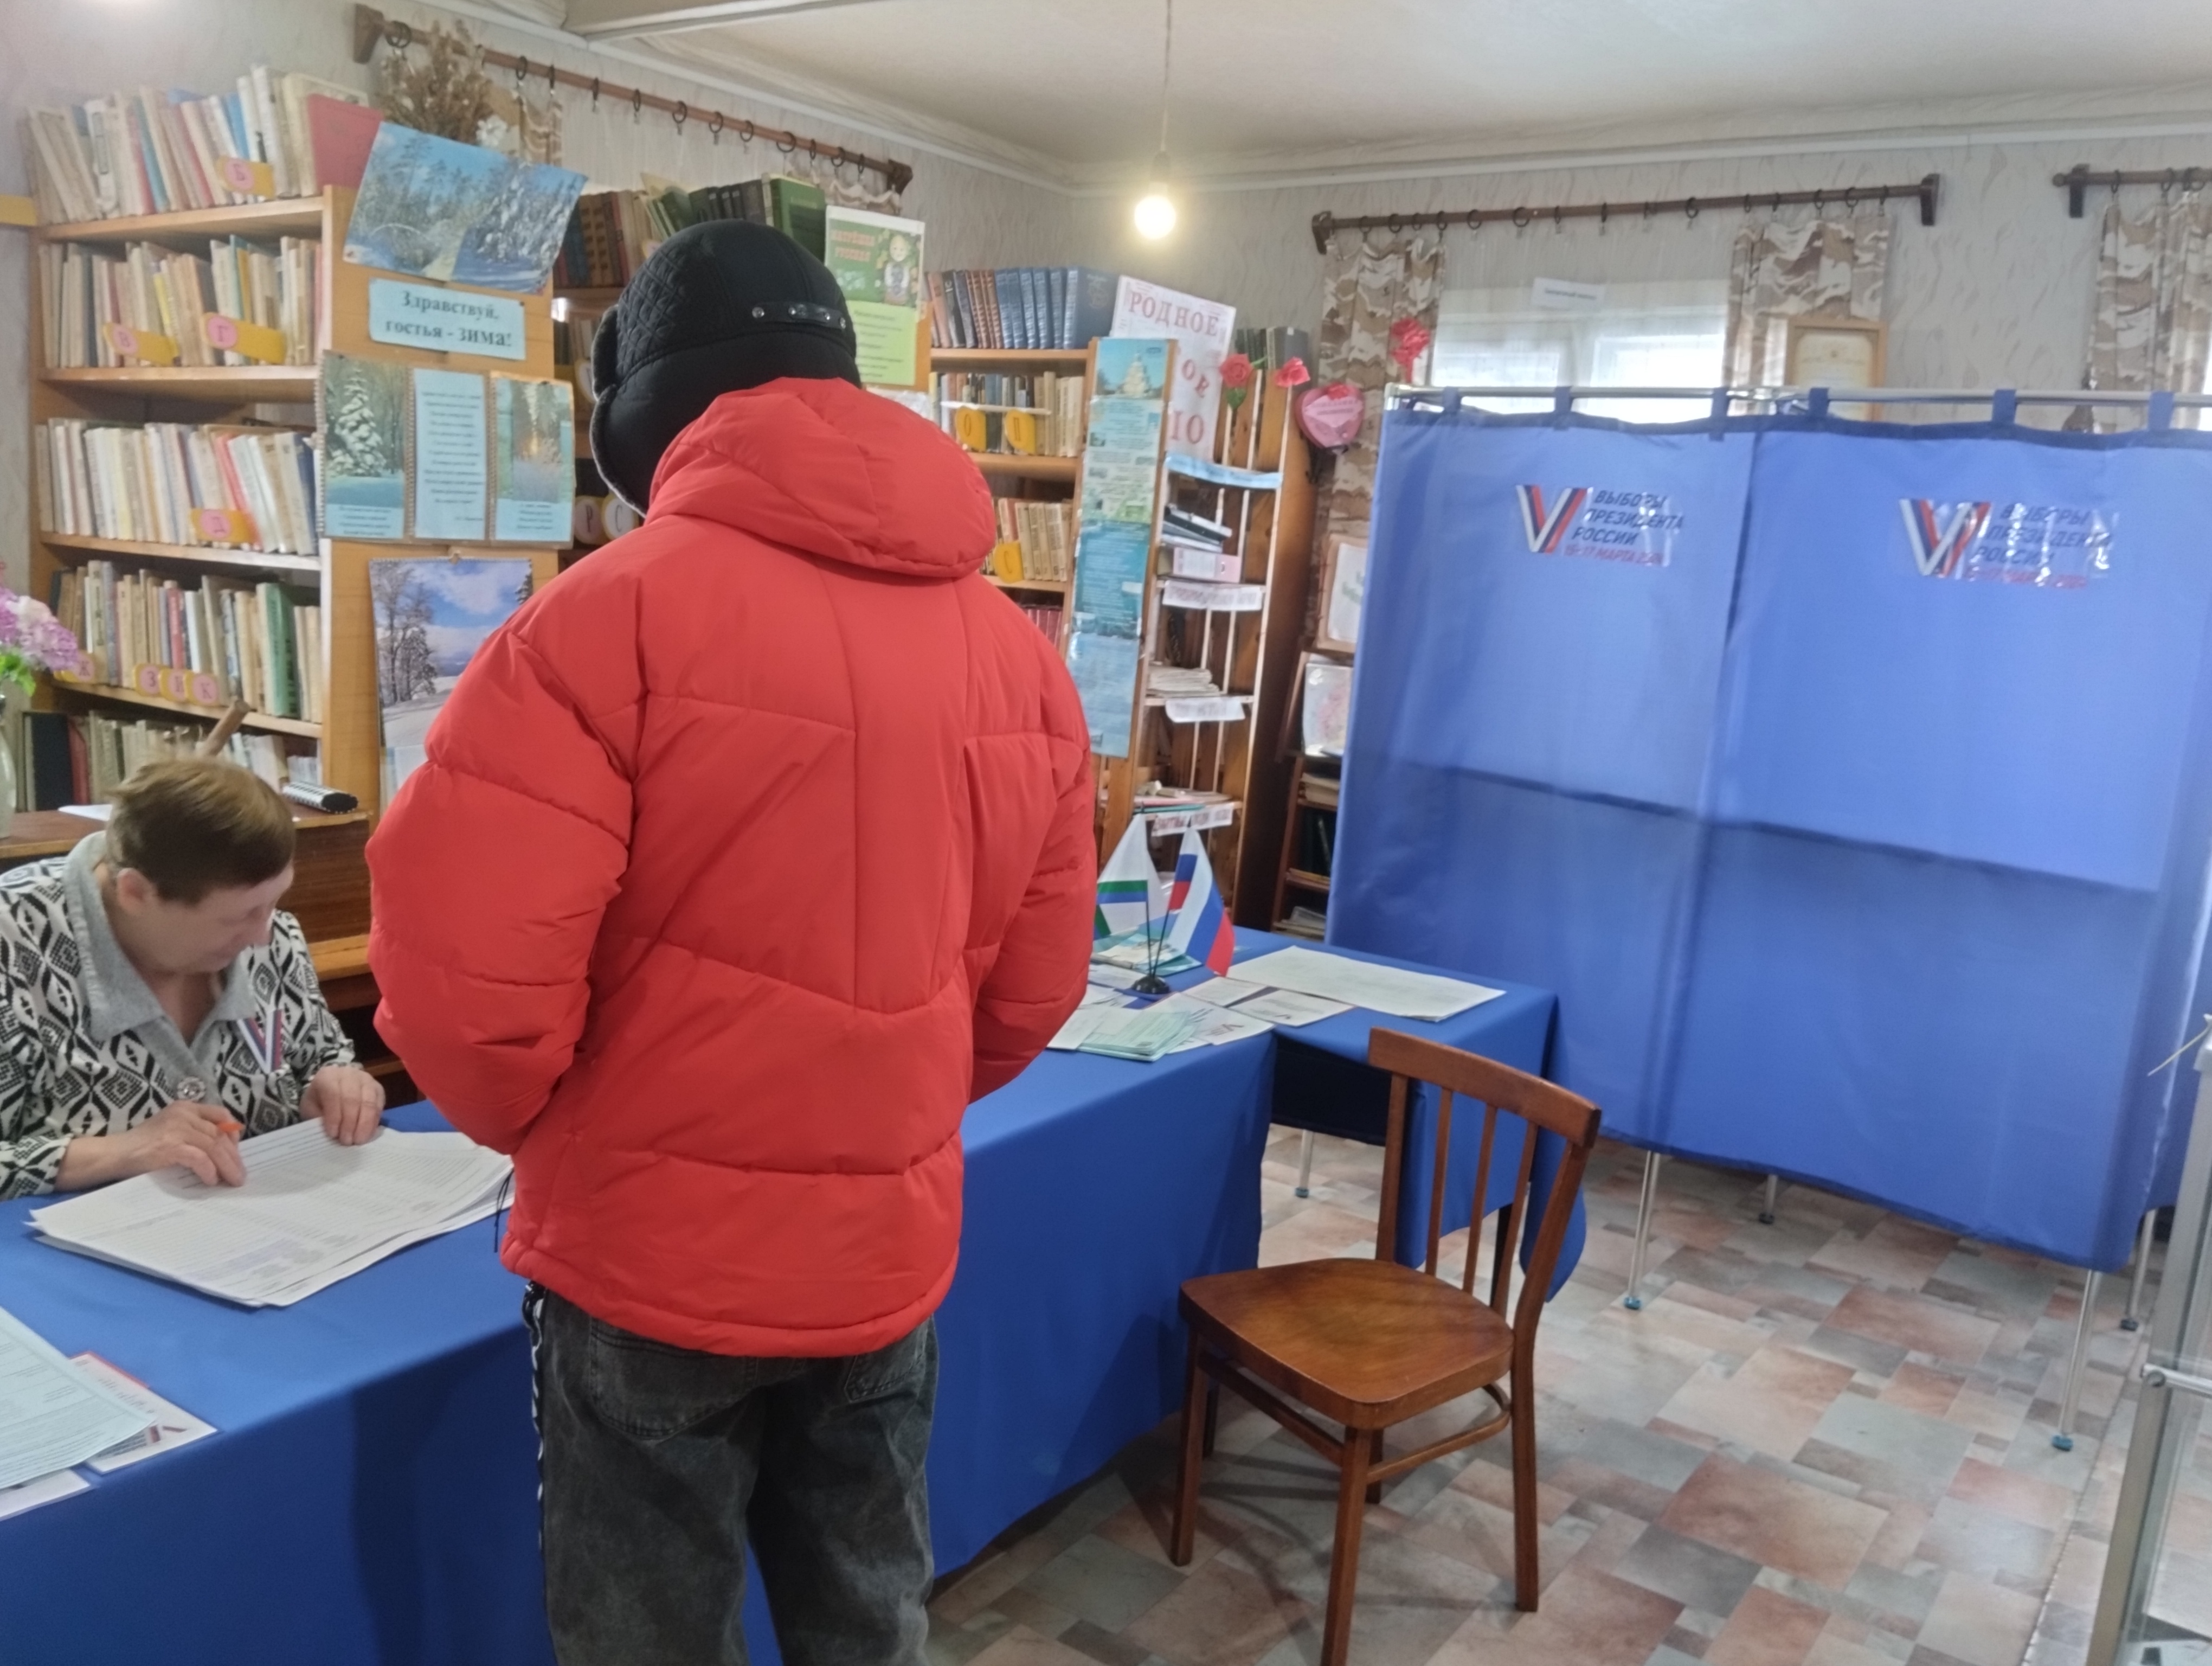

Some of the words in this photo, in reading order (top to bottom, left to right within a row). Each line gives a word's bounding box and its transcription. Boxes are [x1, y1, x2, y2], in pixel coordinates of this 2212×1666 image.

[1128, 291, 1219, 337] РОДНОЕ
[385, 320, 442, 338] гостья
[459, 327, 513, 347] зима!
[1593, 489, 1668, 510] ВЫБОРЫ
[586, 506, 594, 533] Р
[1585, 507, 1684, 530] ПРЕЗИДЕНТА
[2001, 504, 2091, 526] ВБРЫ
[1572, 526, 1640, 546] РОССИИ
[1976, 546, 2054, 565] РОССИ
